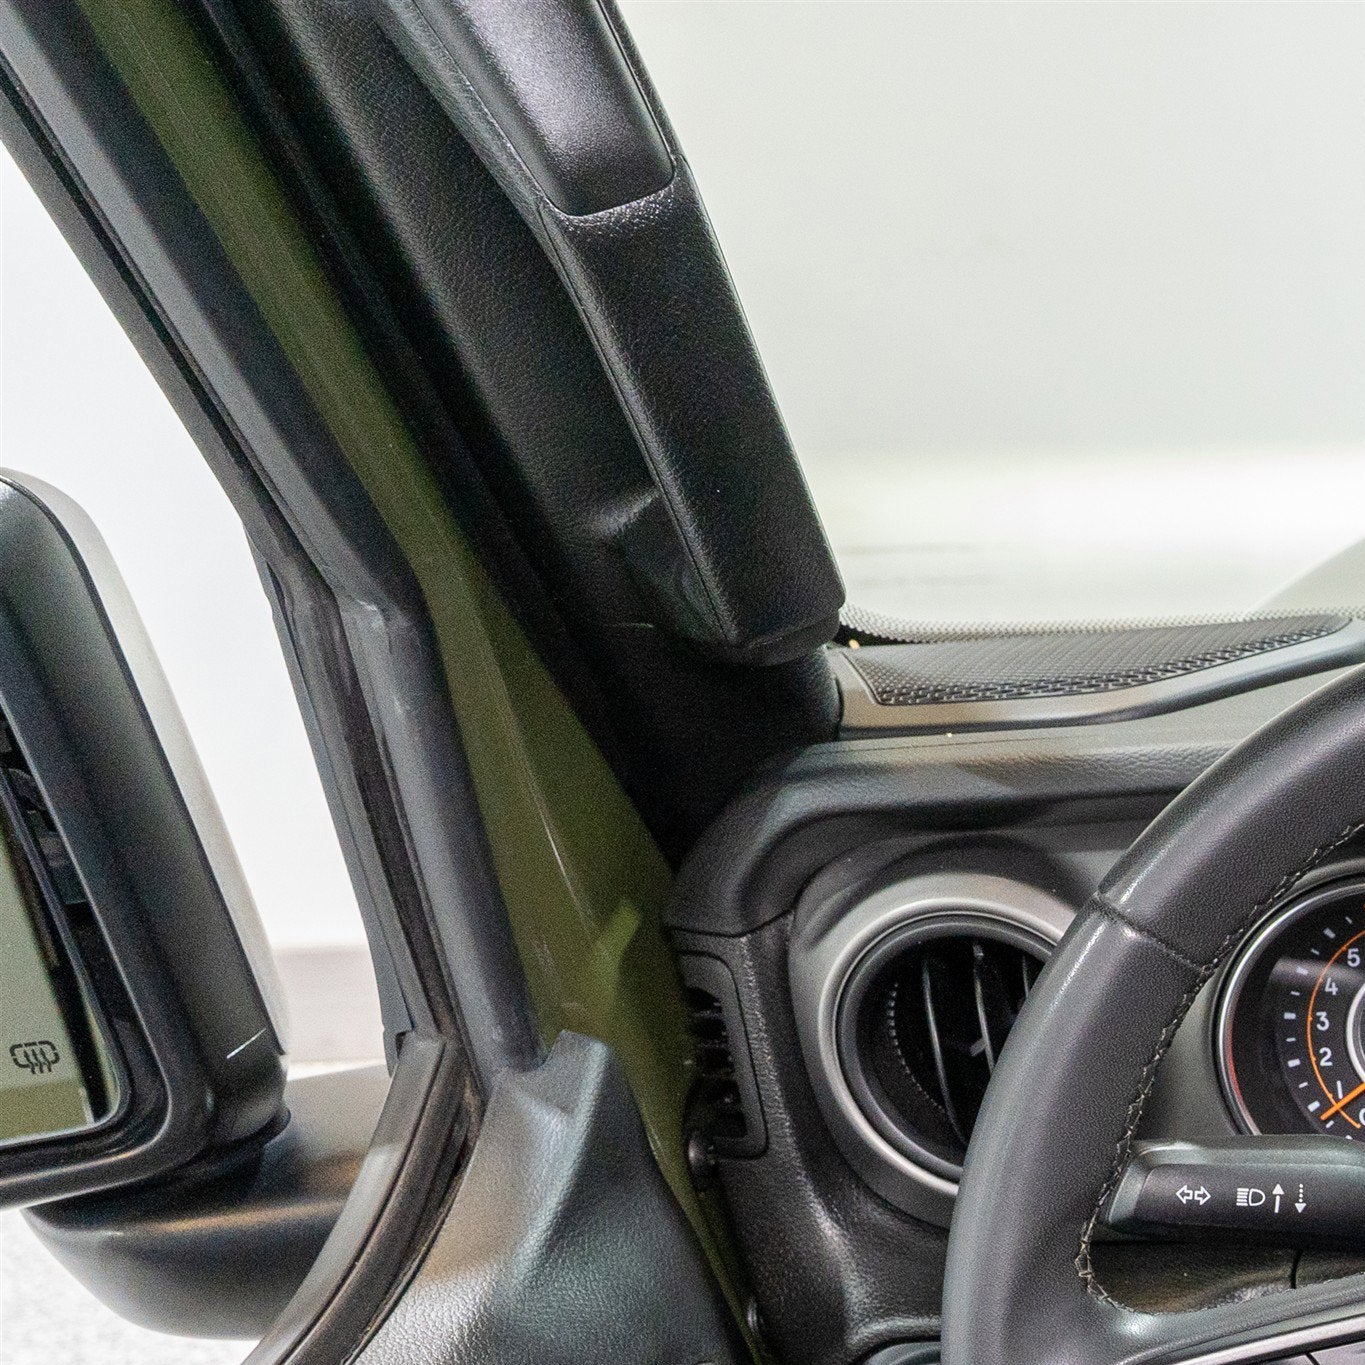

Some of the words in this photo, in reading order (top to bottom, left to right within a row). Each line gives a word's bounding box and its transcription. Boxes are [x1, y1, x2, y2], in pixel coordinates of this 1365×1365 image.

[1347, 949, 1361, 966] 5
[1324, 977, 1338, 994] 4
[1317, 1013, 1329, 1030] 3
[1319, 1048, 1332, 1065] 2
